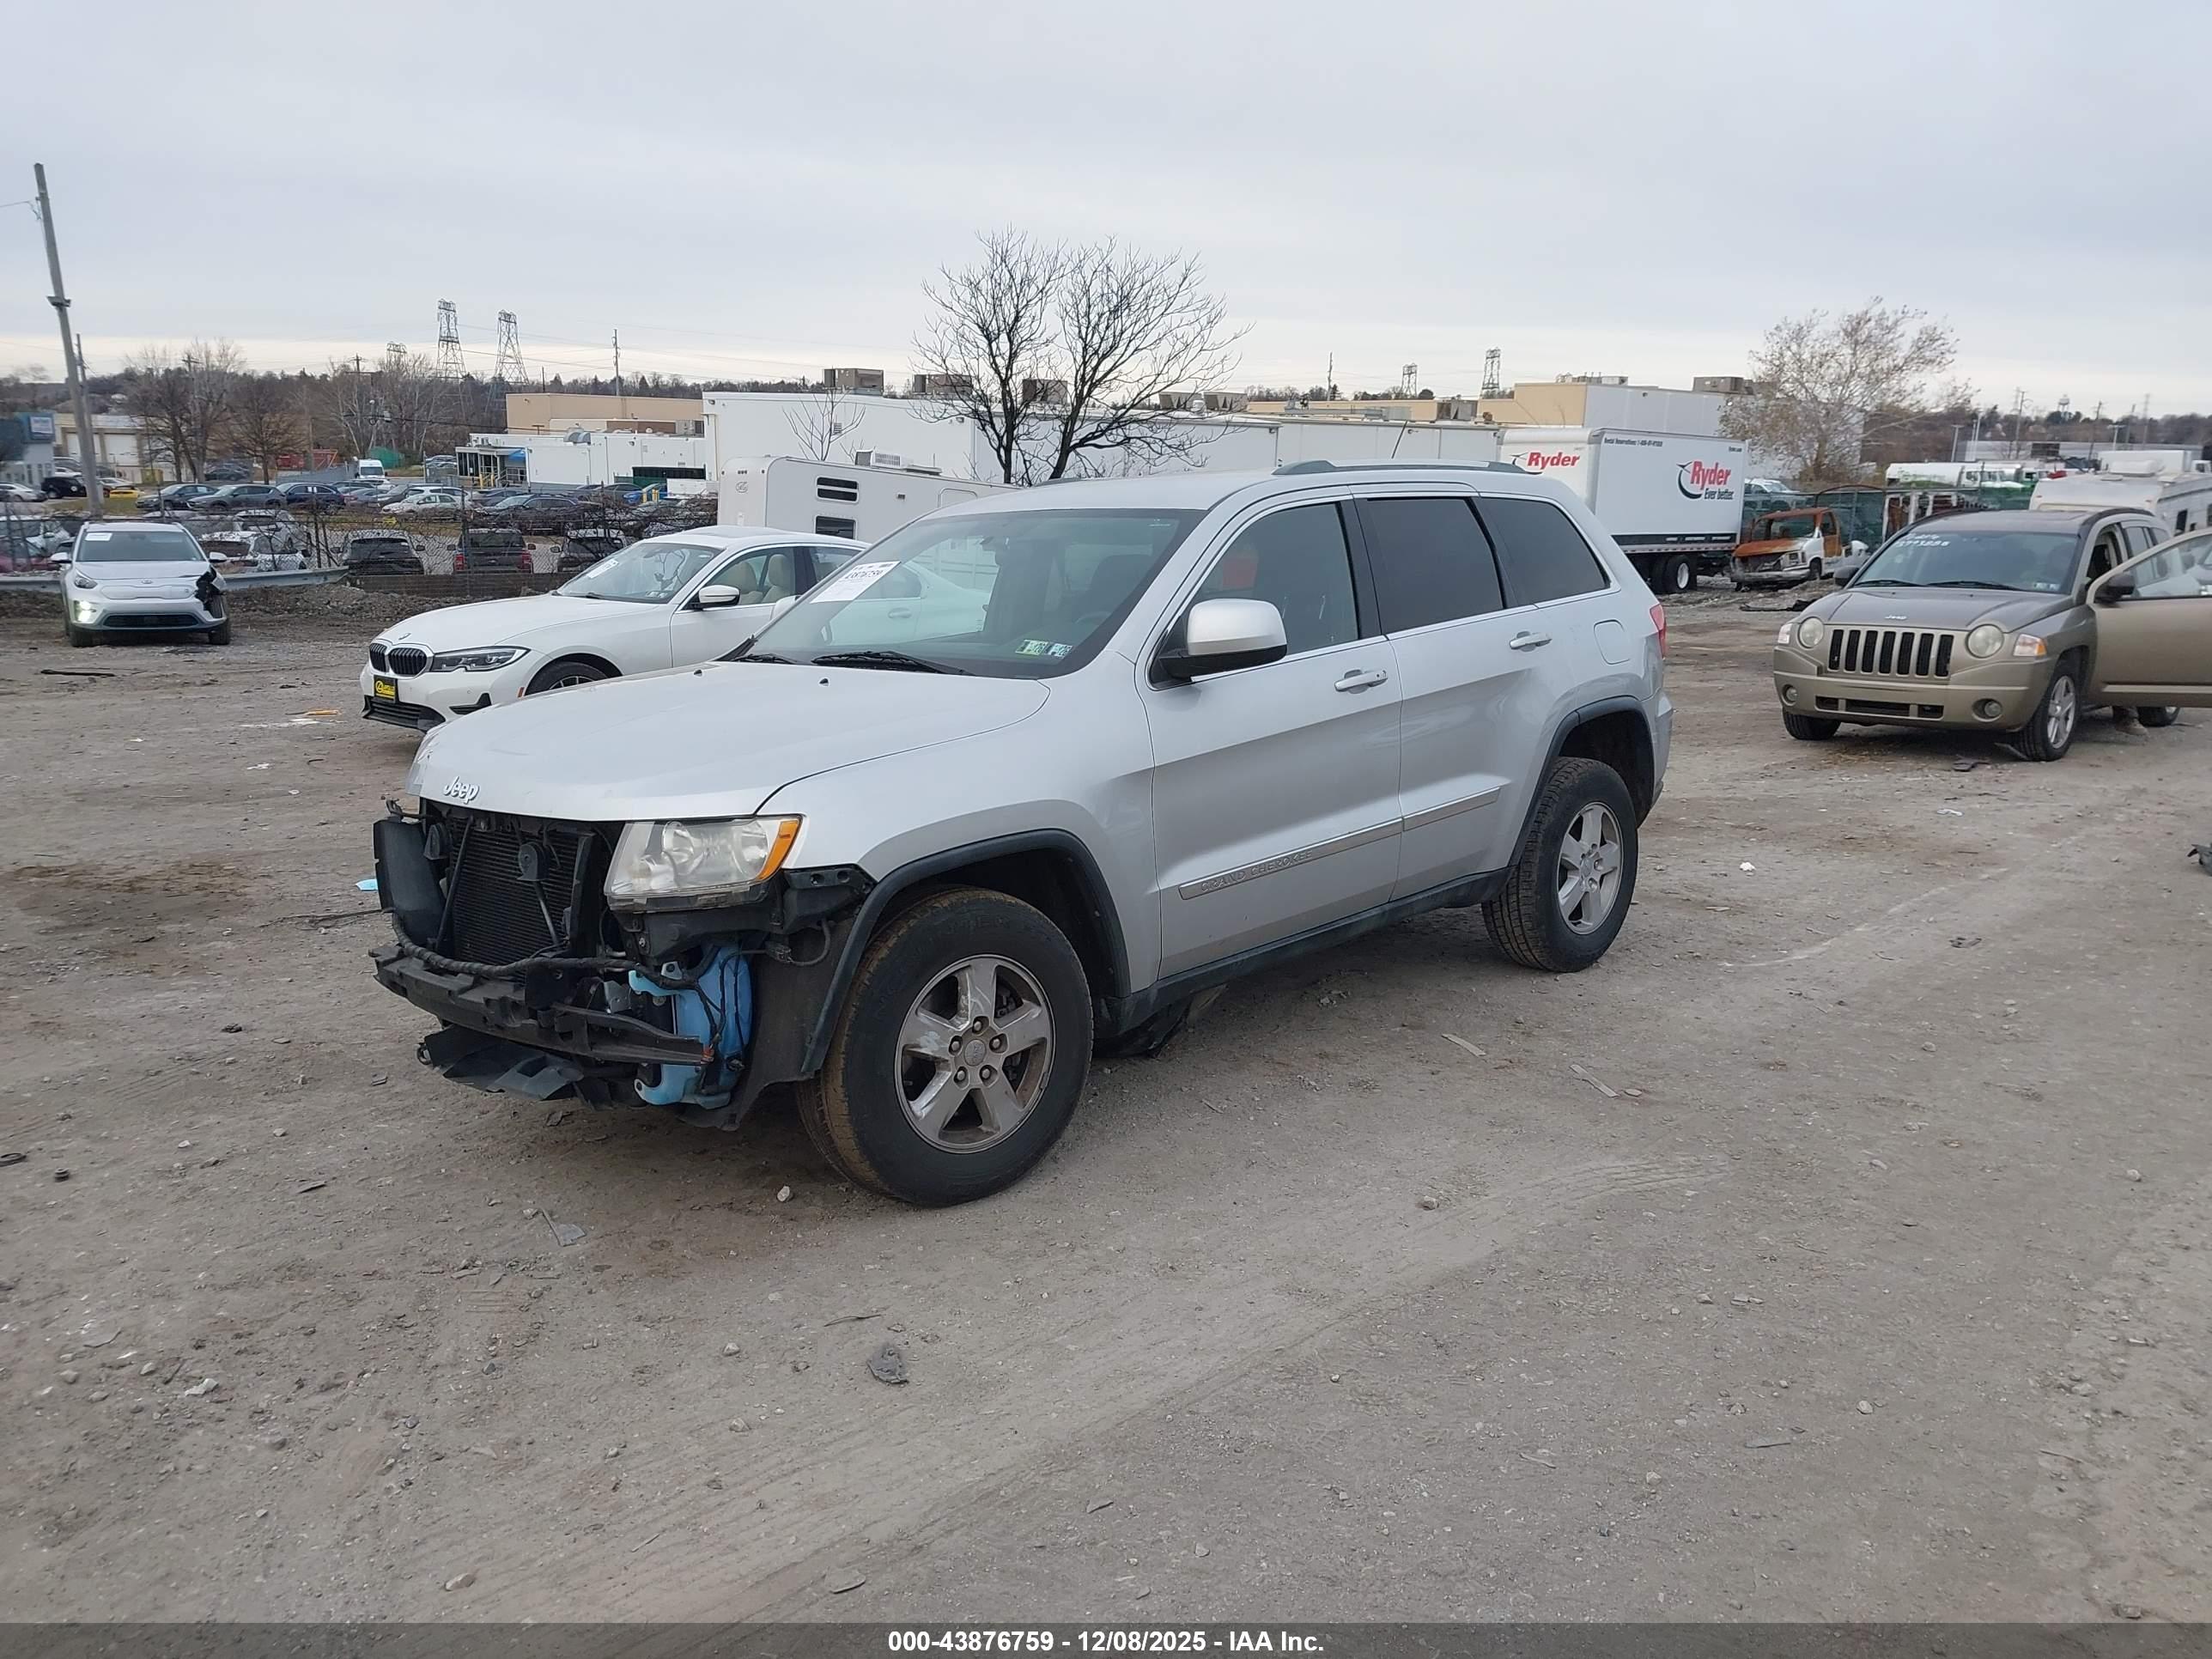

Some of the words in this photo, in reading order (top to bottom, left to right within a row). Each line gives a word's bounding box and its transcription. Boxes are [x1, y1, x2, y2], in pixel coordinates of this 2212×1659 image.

[1528, 452, 1581, 470] Ryder
[1690, 460, 1731, 489] Ryder
[443, 775, 480, 805] Jeep
[1200, 870, 1246, 892] GRAND
[1249, 849, 1313, 877] CHEROKEE
